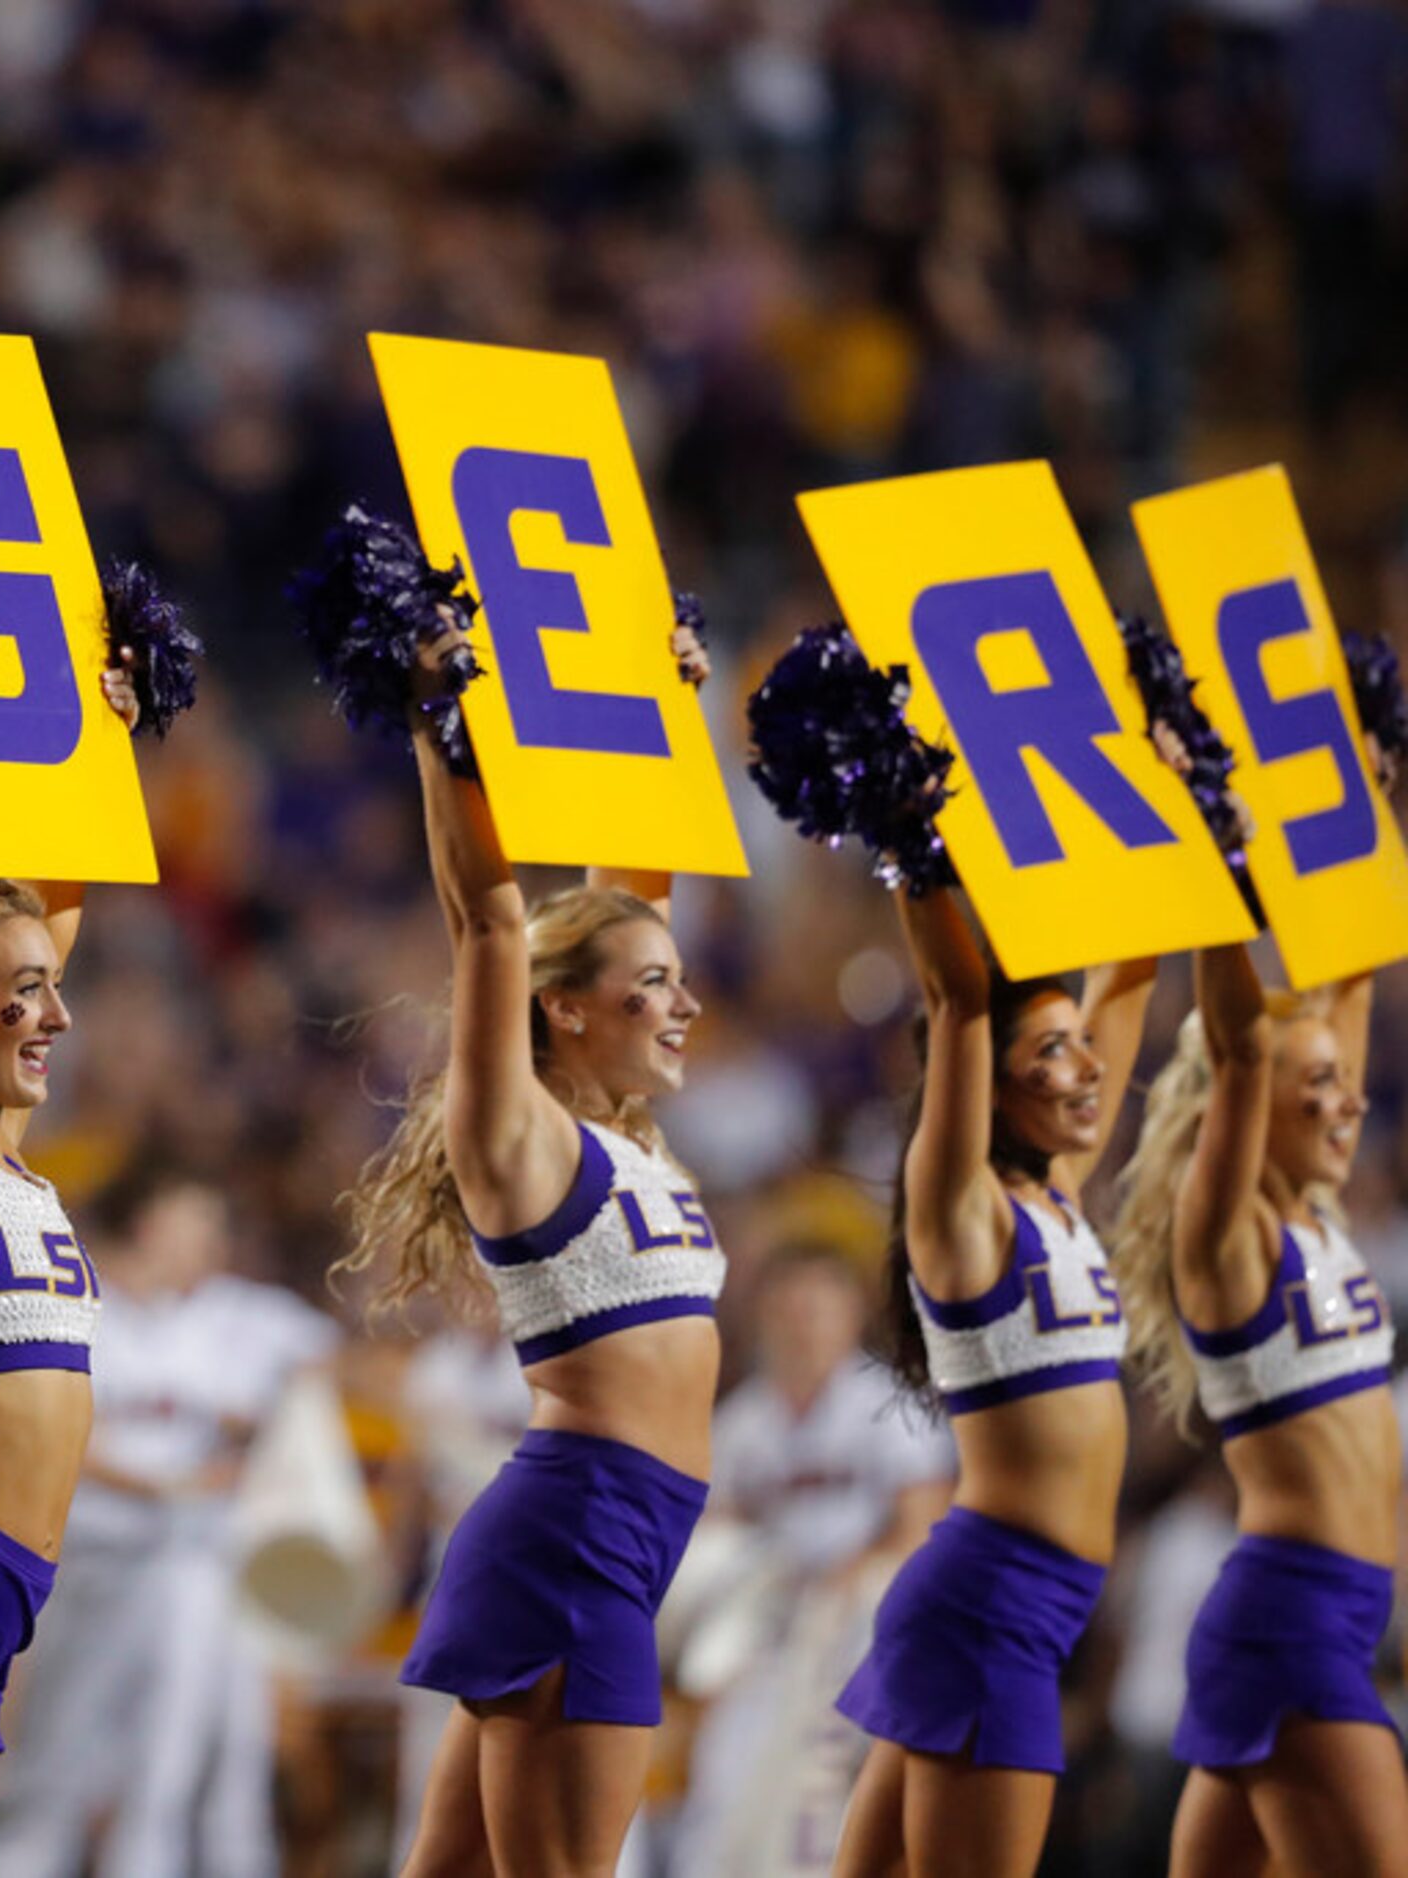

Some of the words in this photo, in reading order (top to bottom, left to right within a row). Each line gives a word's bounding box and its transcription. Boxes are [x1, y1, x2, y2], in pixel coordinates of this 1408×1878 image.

[453, 448, 670, 757] E
[912, 570, 1177, 868] R
[1218, 579, 1377, 875] S
[608, 1189, 716, 1257] LS
[1024, 1264, 1122, 1335] LS
[1284, 1272, 1388, 1348] LS
